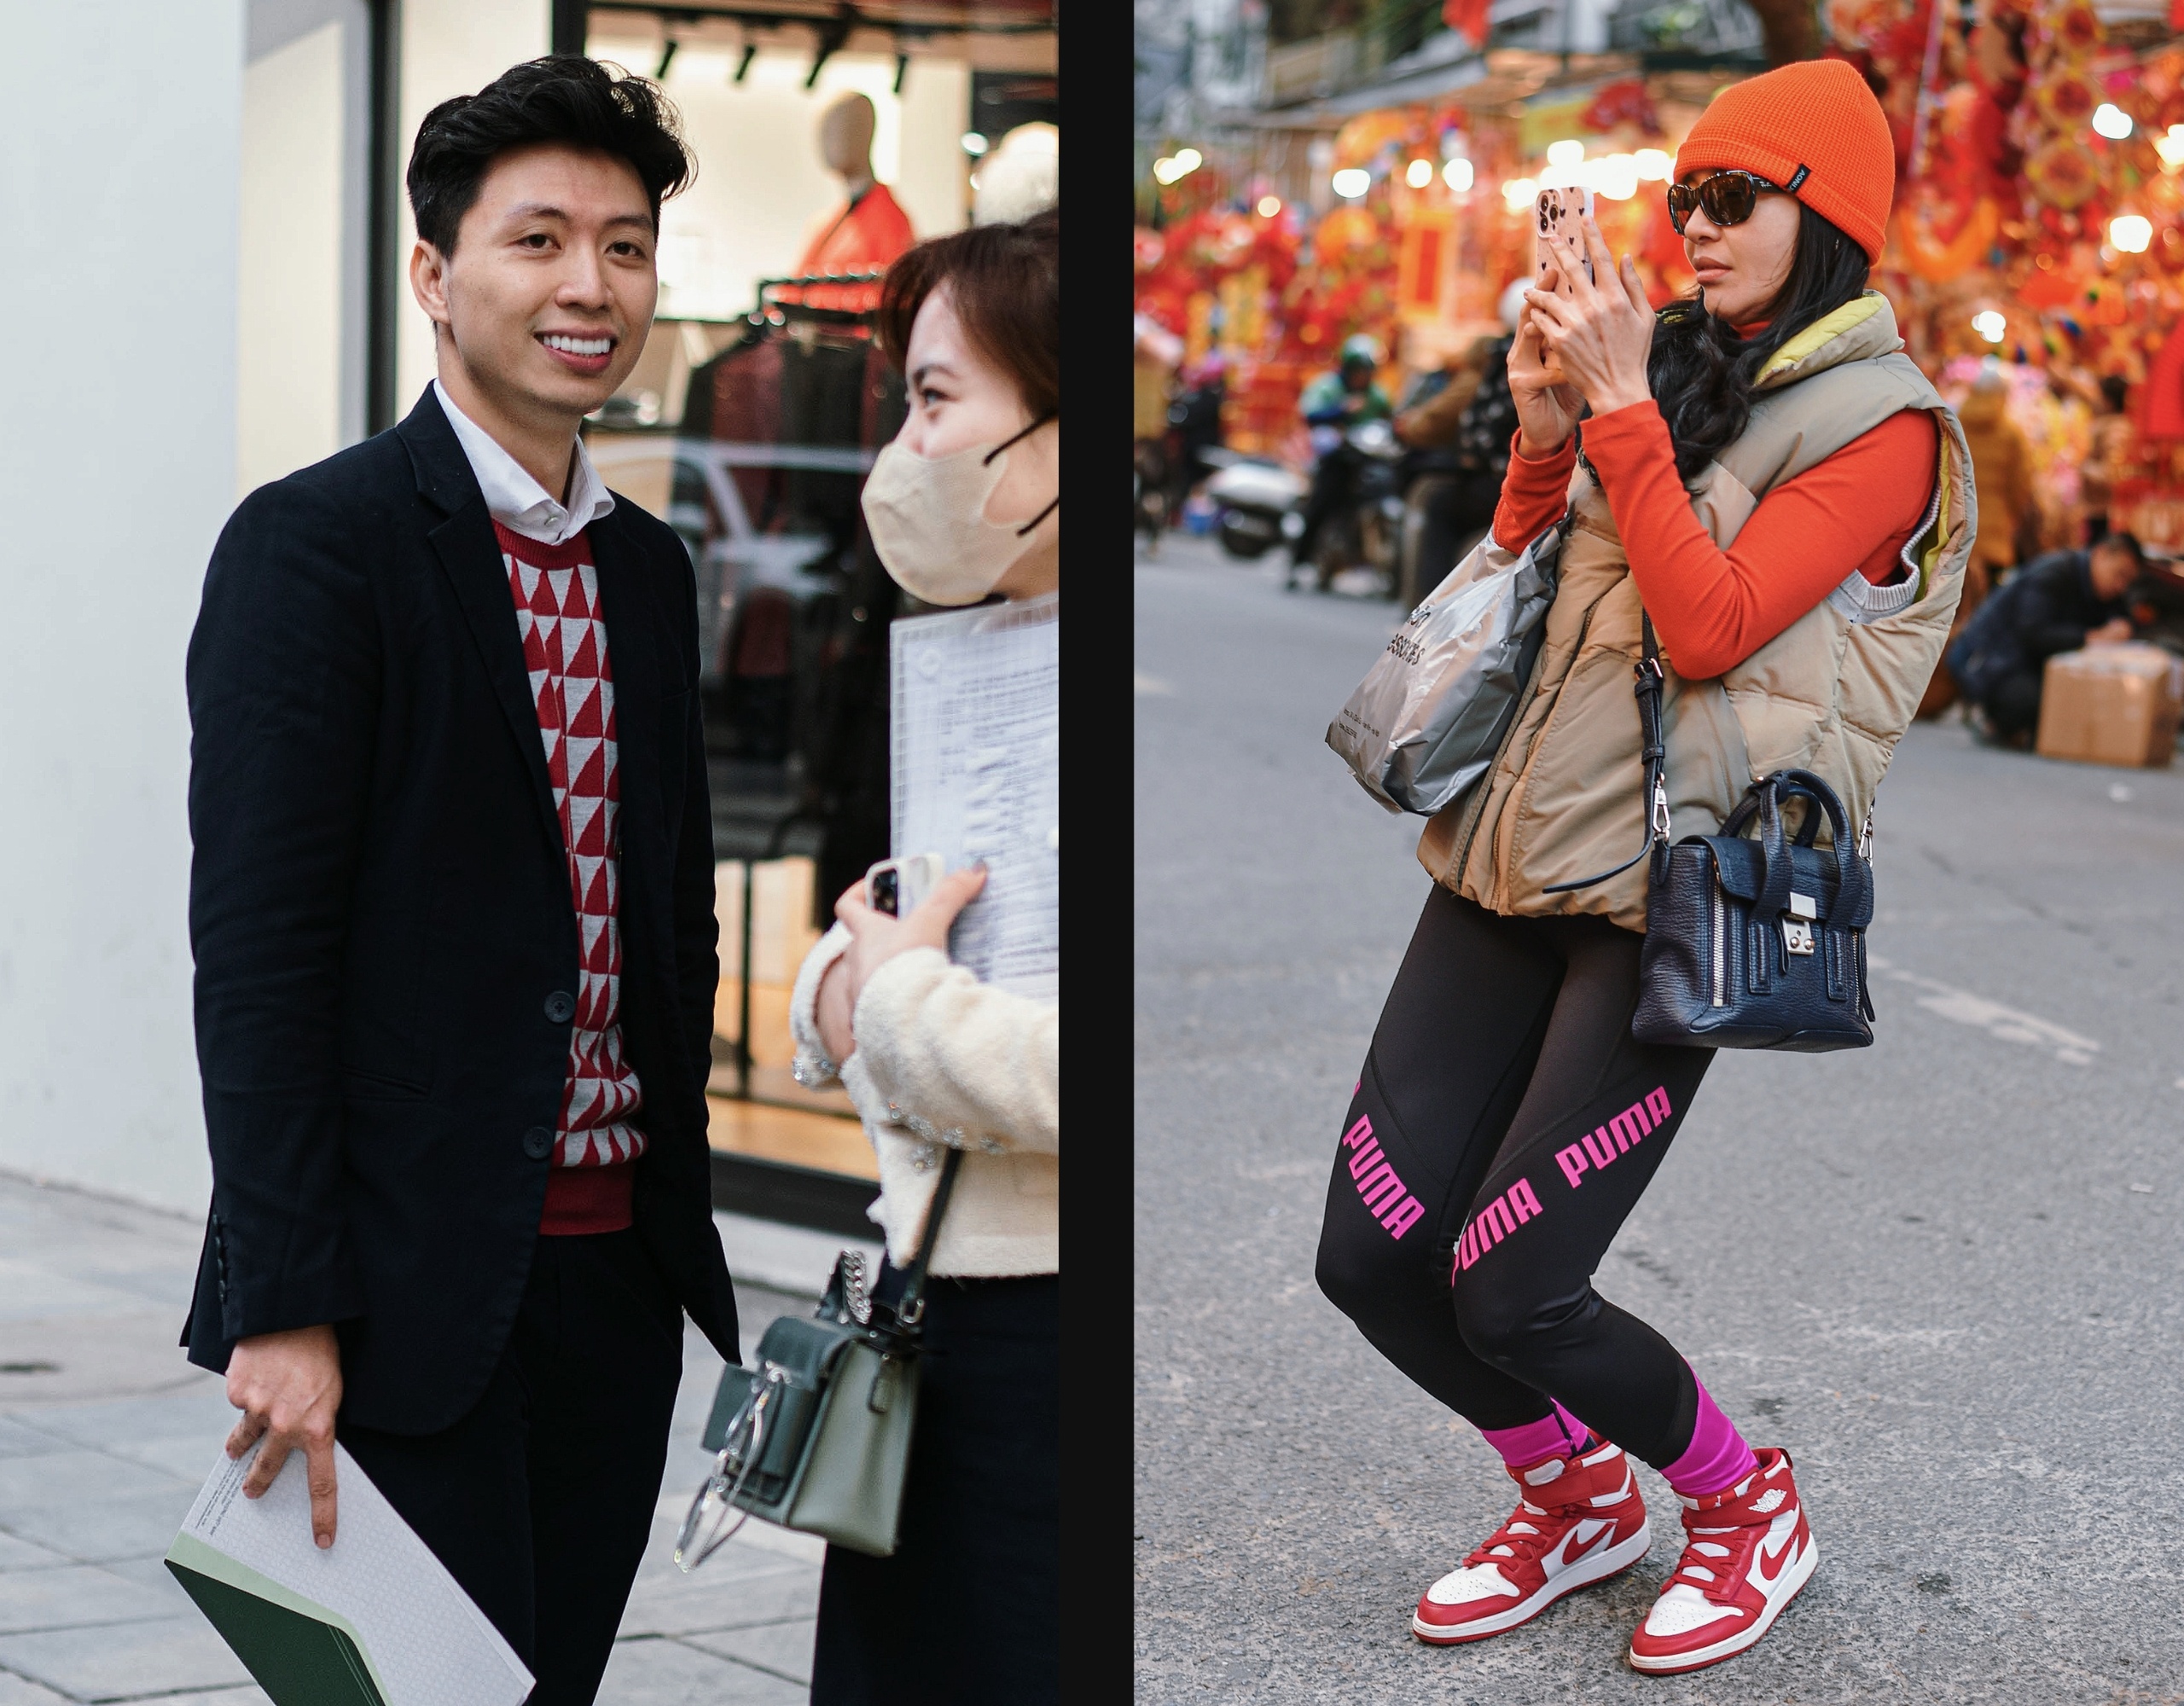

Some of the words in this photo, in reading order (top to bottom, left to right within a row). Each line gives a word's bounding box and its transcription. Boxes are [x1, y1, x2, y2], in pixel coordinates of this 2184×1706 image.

[1342, 1113, 1426, 1240] PUMA
[1554, 1085, 1672, 1189] PUMA
[1452, 1177, 1543, 1288] UMA
